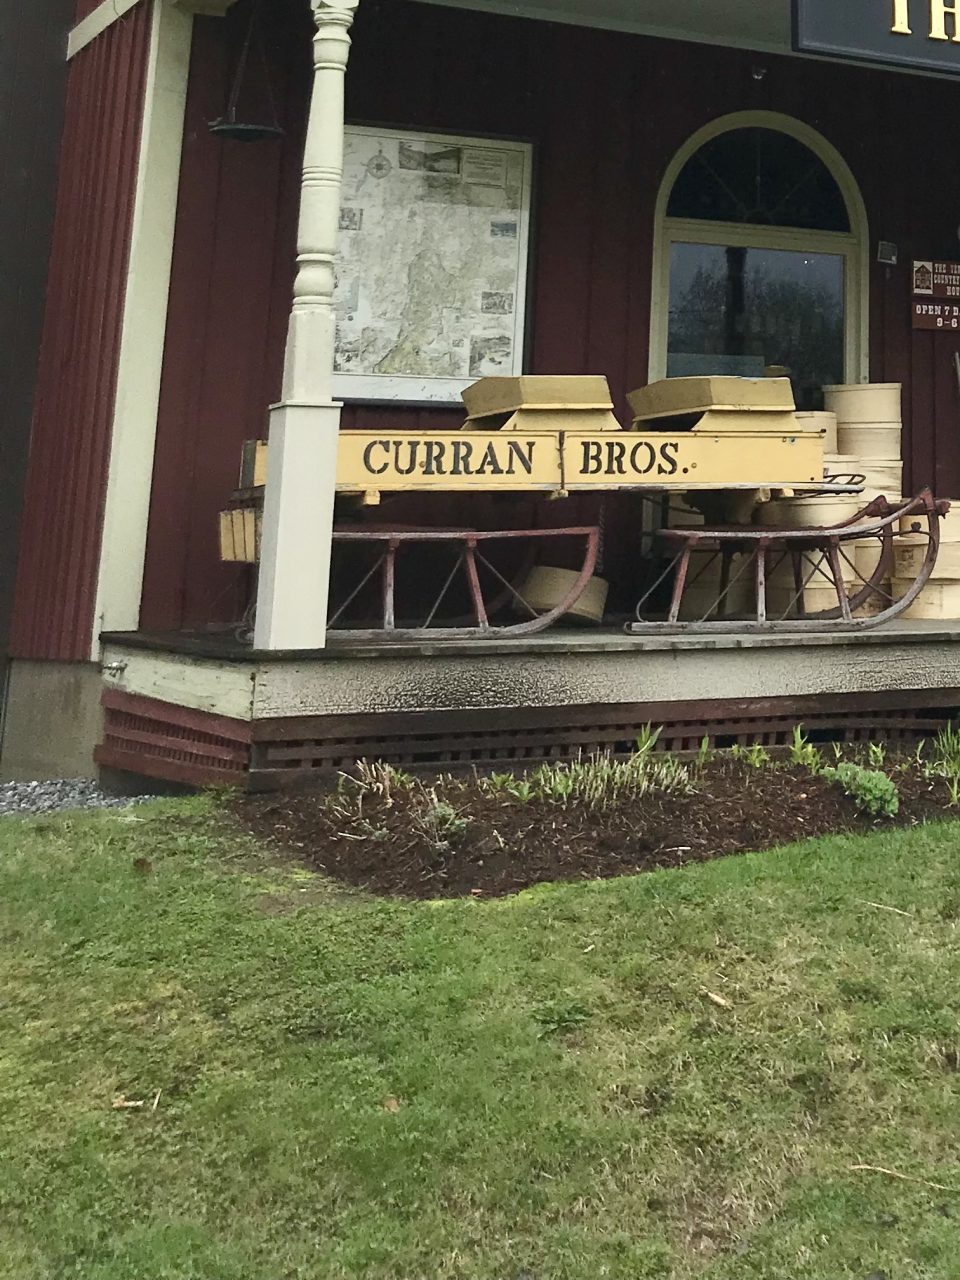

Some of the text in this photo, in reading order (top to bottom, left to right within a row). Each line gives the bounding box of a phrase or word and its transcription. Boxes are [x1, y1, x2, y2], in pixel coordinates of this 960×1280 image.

[934, 263, 946, 273] THE
[933, 274, 960, 285] COUNTRY
[916, 304, 941, 315] OPEN
[944, 306, 950, 316] 7
[363, 440, 690, 475] CURRAN BROS.
